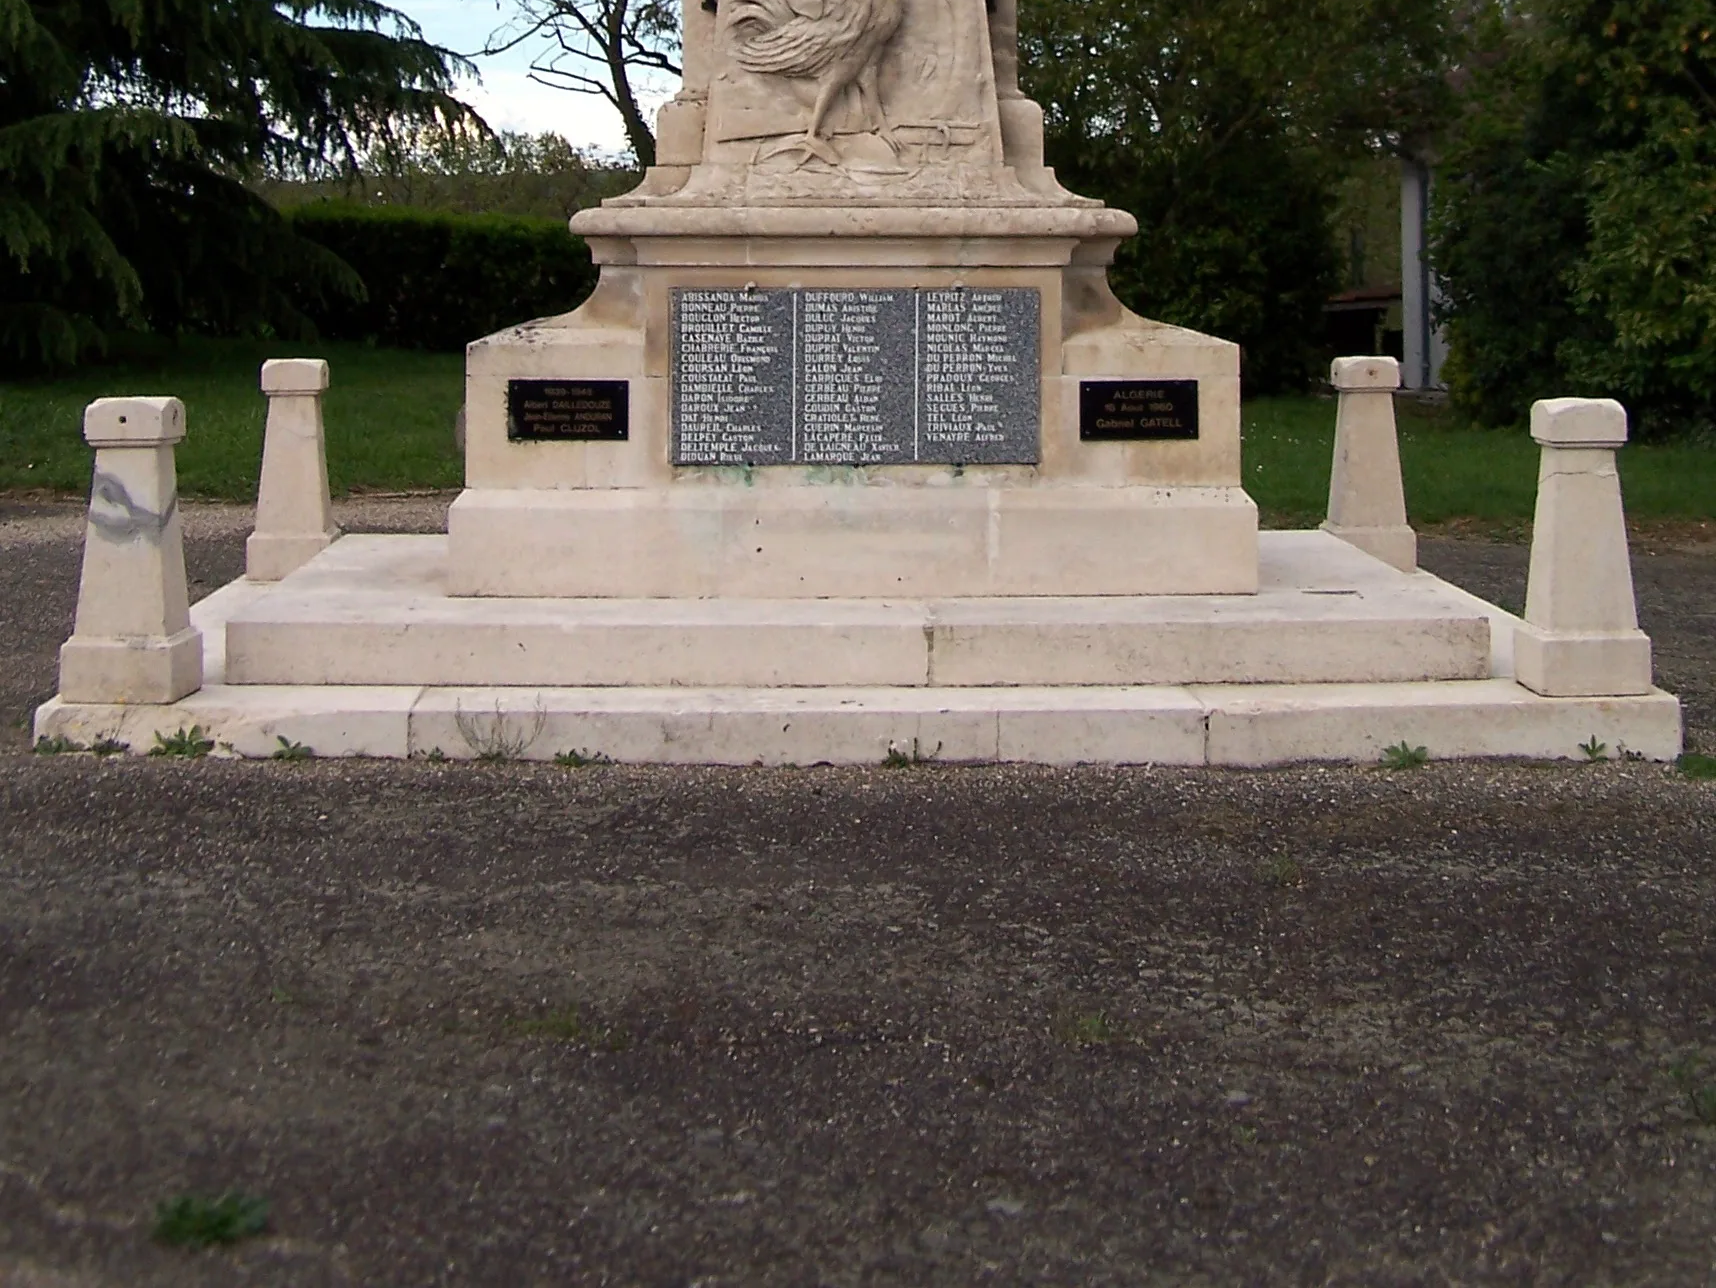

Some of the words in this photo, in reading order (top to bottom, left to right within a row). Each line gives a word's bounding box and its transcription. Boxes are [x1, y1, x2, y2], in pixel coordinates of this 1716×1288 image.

[724, 403, 745, 412] JEAN
[1096, 418, 1134, 428] Gabriel
[1140, 418, 1182, 428] GATELL
[533, 424, 555, 432] Paul
